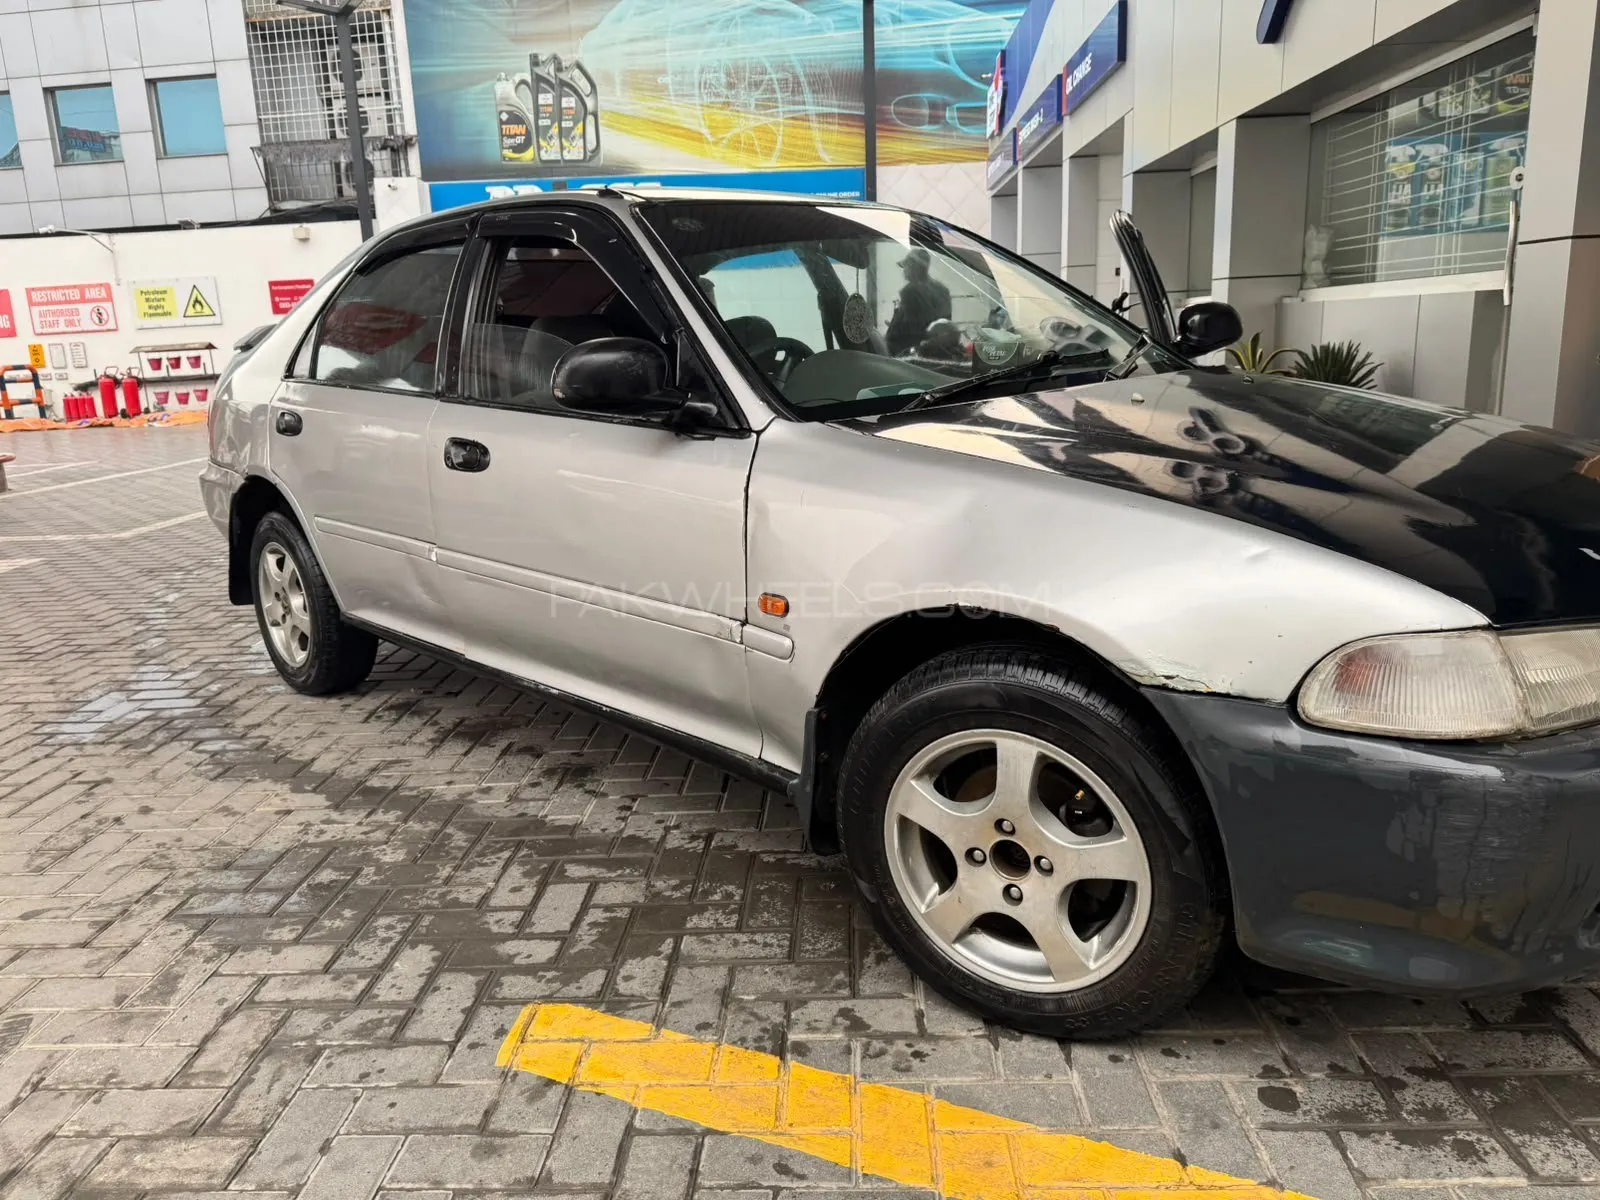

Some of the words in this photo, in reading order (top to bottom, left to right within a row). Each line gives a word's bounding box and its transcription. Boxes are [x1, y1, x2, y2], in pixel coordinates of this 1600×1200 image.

[501, 124, 526, 136] TITAN
[31, 289, 80, 302] RESTRICTED
[85, 287, 107, 299] AREA
[38, 308, 80, 318] AUTHORISED
[40, 320, 60, 329] STAFF
[64, 318, 82, 328] ONLY
